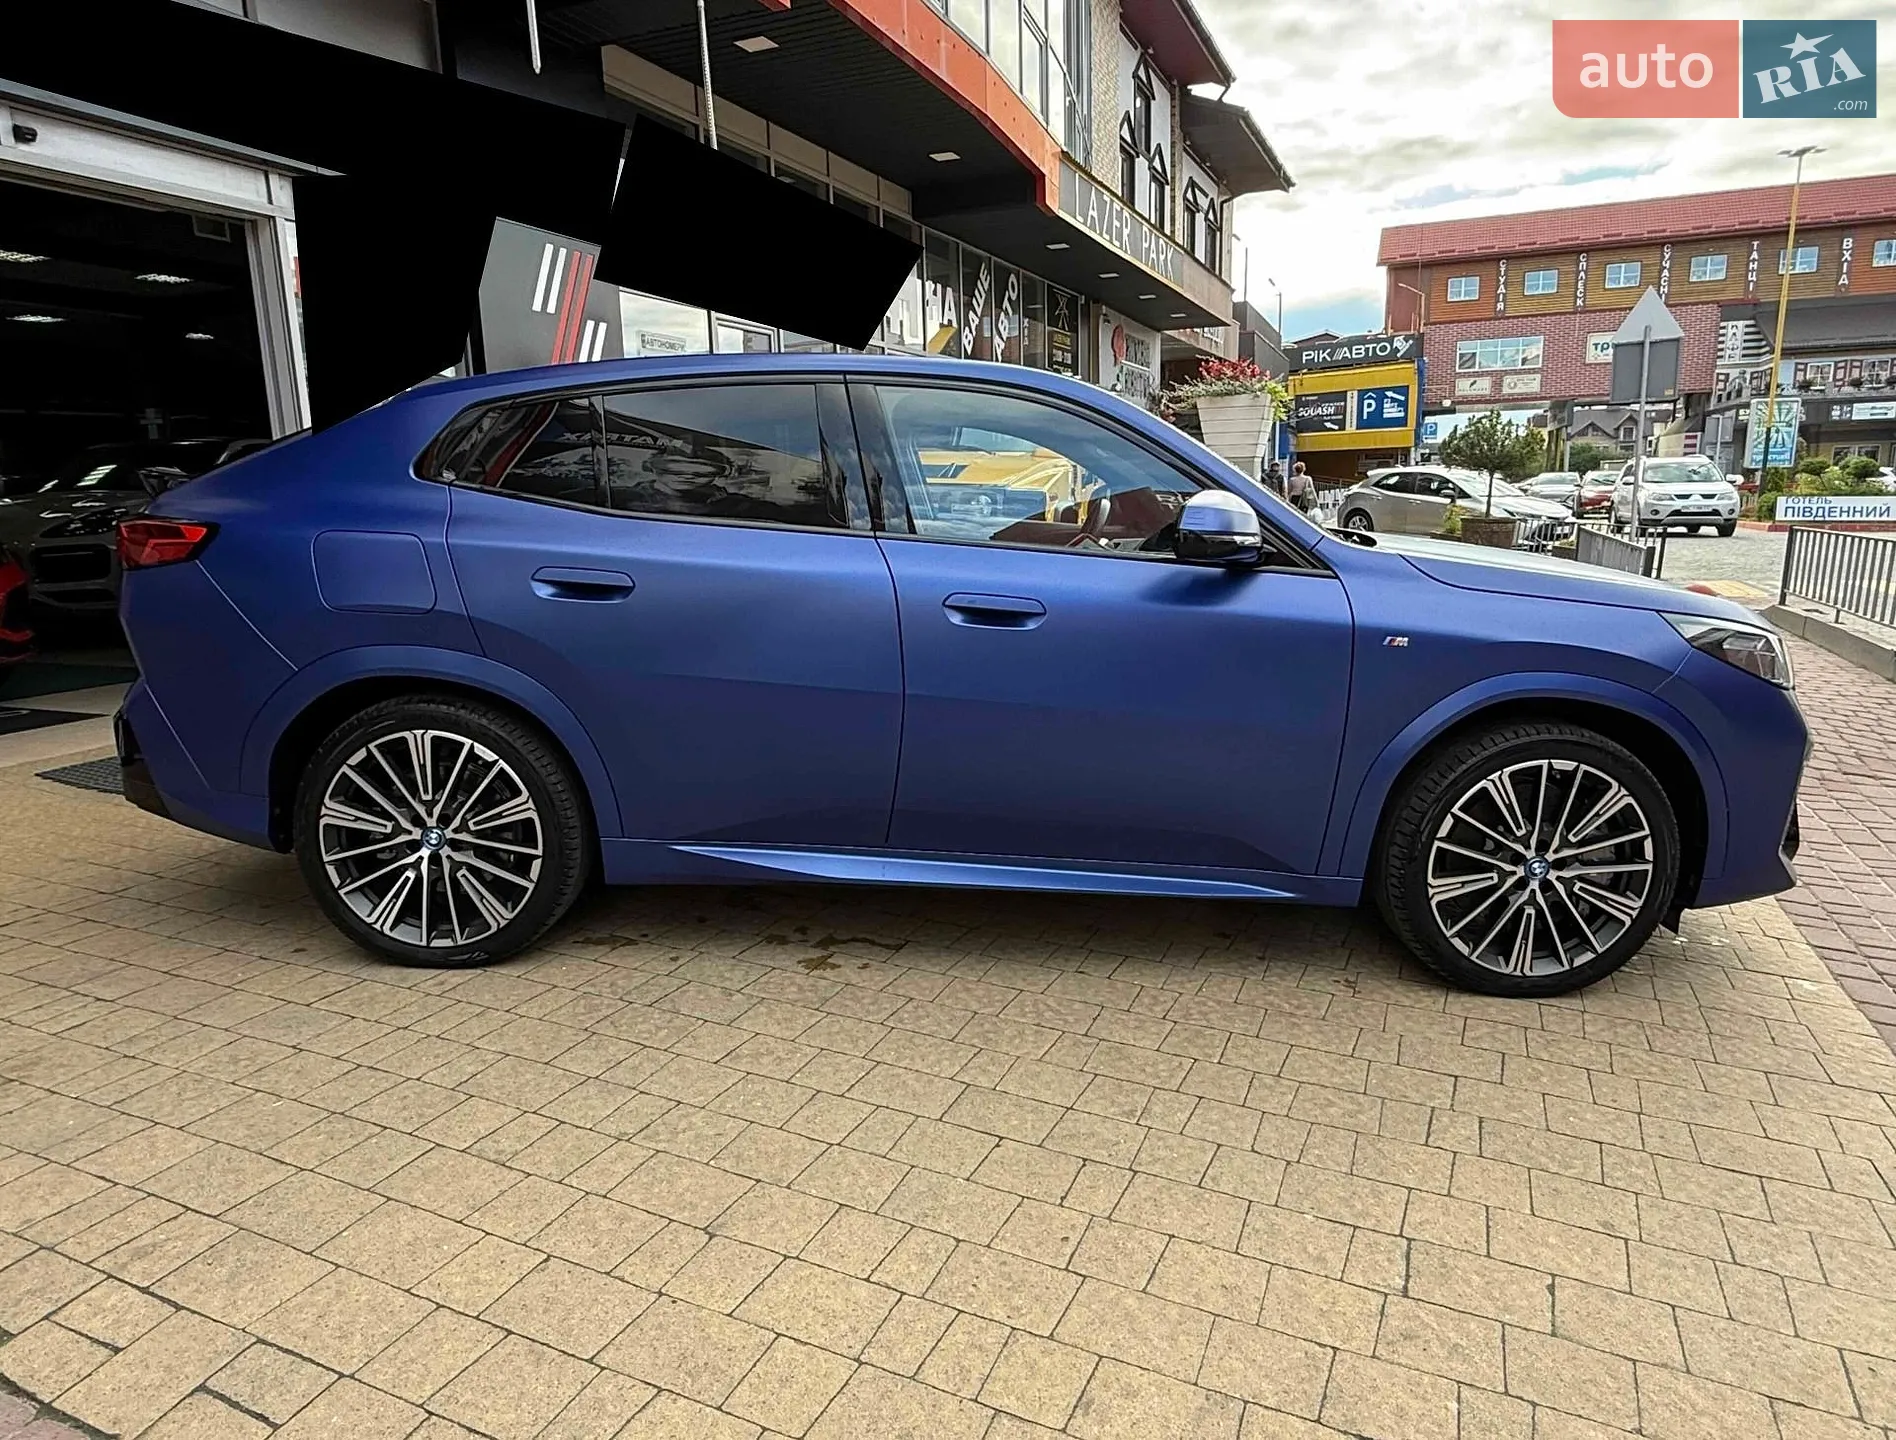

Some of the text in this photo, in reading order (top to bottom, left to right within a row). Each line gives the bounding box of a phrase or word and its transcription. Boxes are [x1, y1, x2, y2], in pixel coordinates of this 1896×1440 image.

[1075, 173, 1174, 281] LAZER PARK
[1496, 259, 1507, 311] СТУДІЯ
[1576, 253, 1588, 306] СПЛЕСК
[1659, 244, 1671, 306] СУЧАСНІ
[1748, 241, 1760, 292] ТАНЦІ
[1838, 238, 1853, 286] ВХІД
[963, 262, 1018, 363] ВАШЕ АВТО
[1784, 503, 1891, 520] ПІВДЕННИЙ
